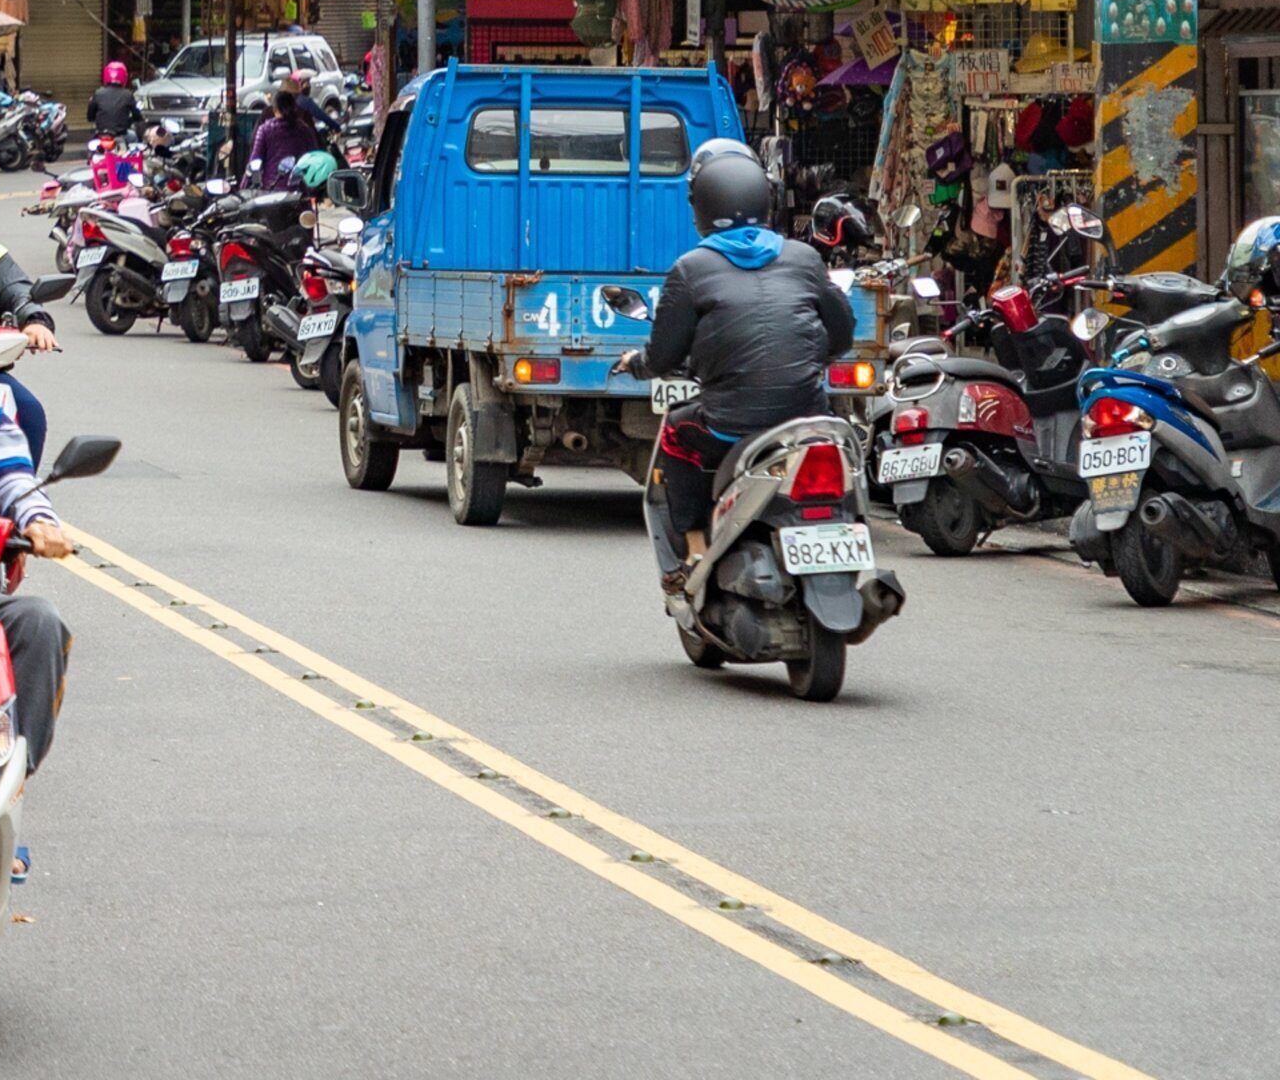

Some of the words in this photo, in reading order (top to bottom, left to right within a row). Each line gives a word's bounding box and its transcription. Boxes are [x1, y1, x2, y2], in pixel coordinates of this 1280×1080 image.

[880, 453, 940, 478] 867-GBU
[1082, 444, 1148, 471] 050-BCY
[787, 536, 871, 569] 882-KXM
